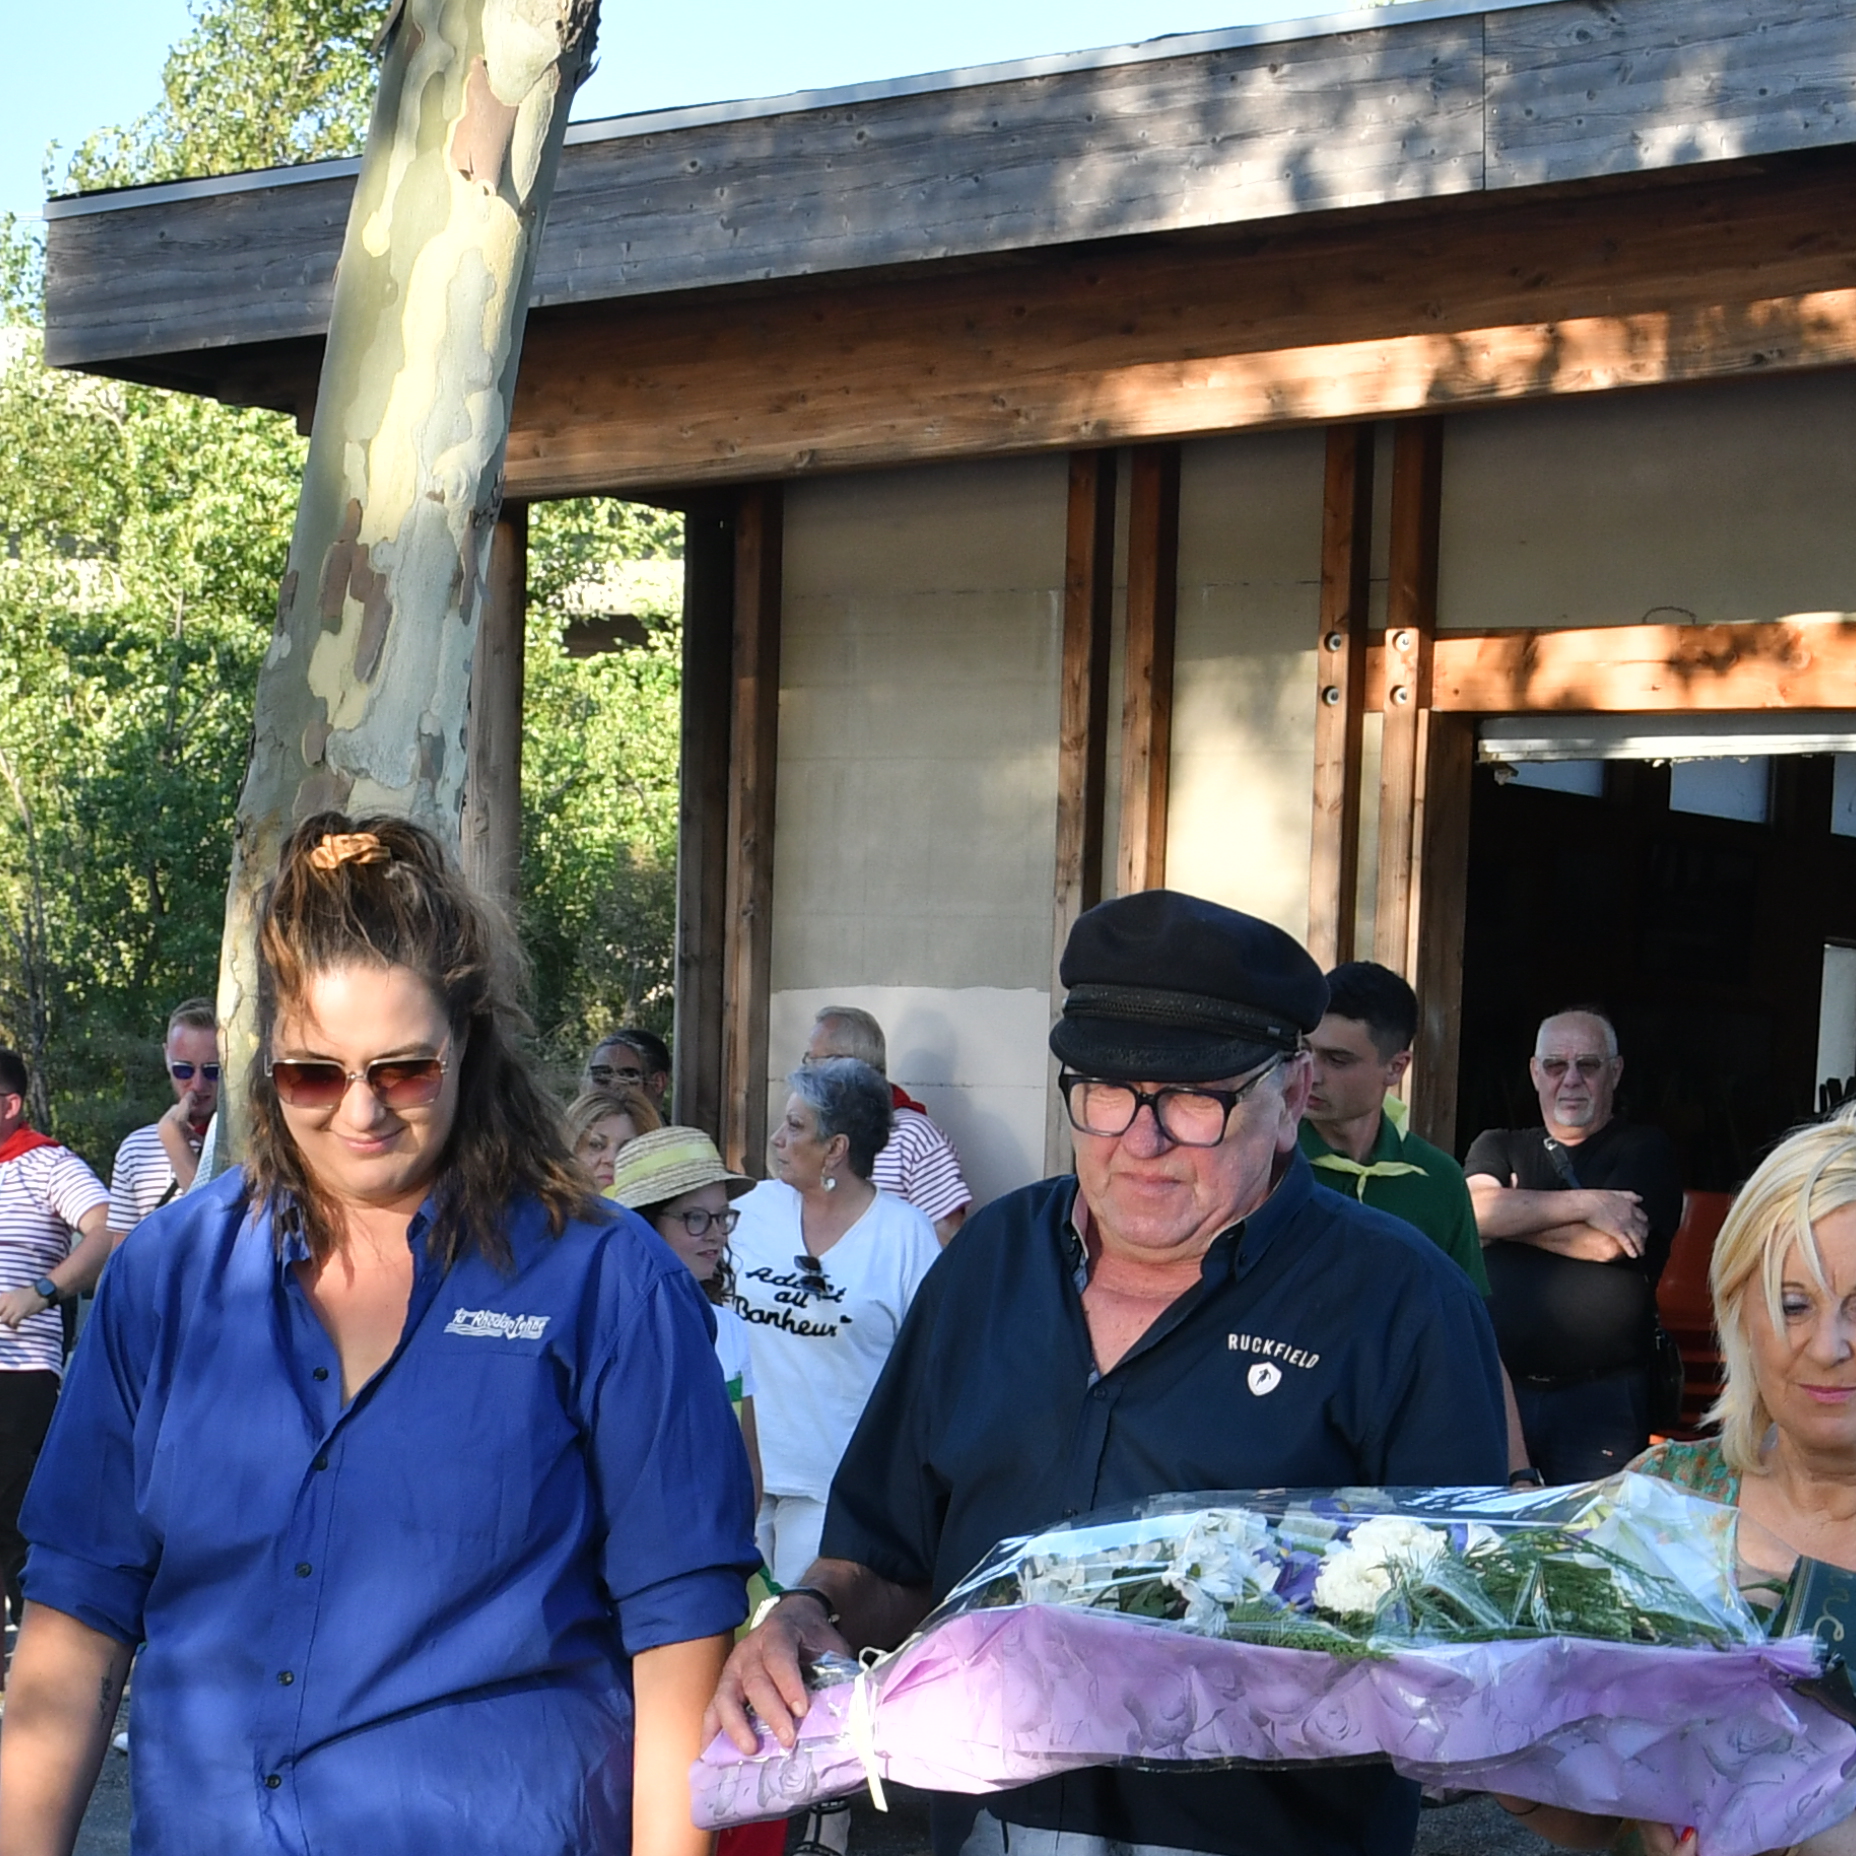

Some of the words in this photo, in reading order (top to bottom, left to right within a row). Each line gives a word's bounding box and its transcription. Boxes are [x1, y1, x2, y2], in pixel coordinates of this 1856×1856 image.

[734, 1295, 837, 1337] Bonheur
[774, 1291, 808, 1308] au
[1228, 1333, 1320, 1369] RUCKFIELD
